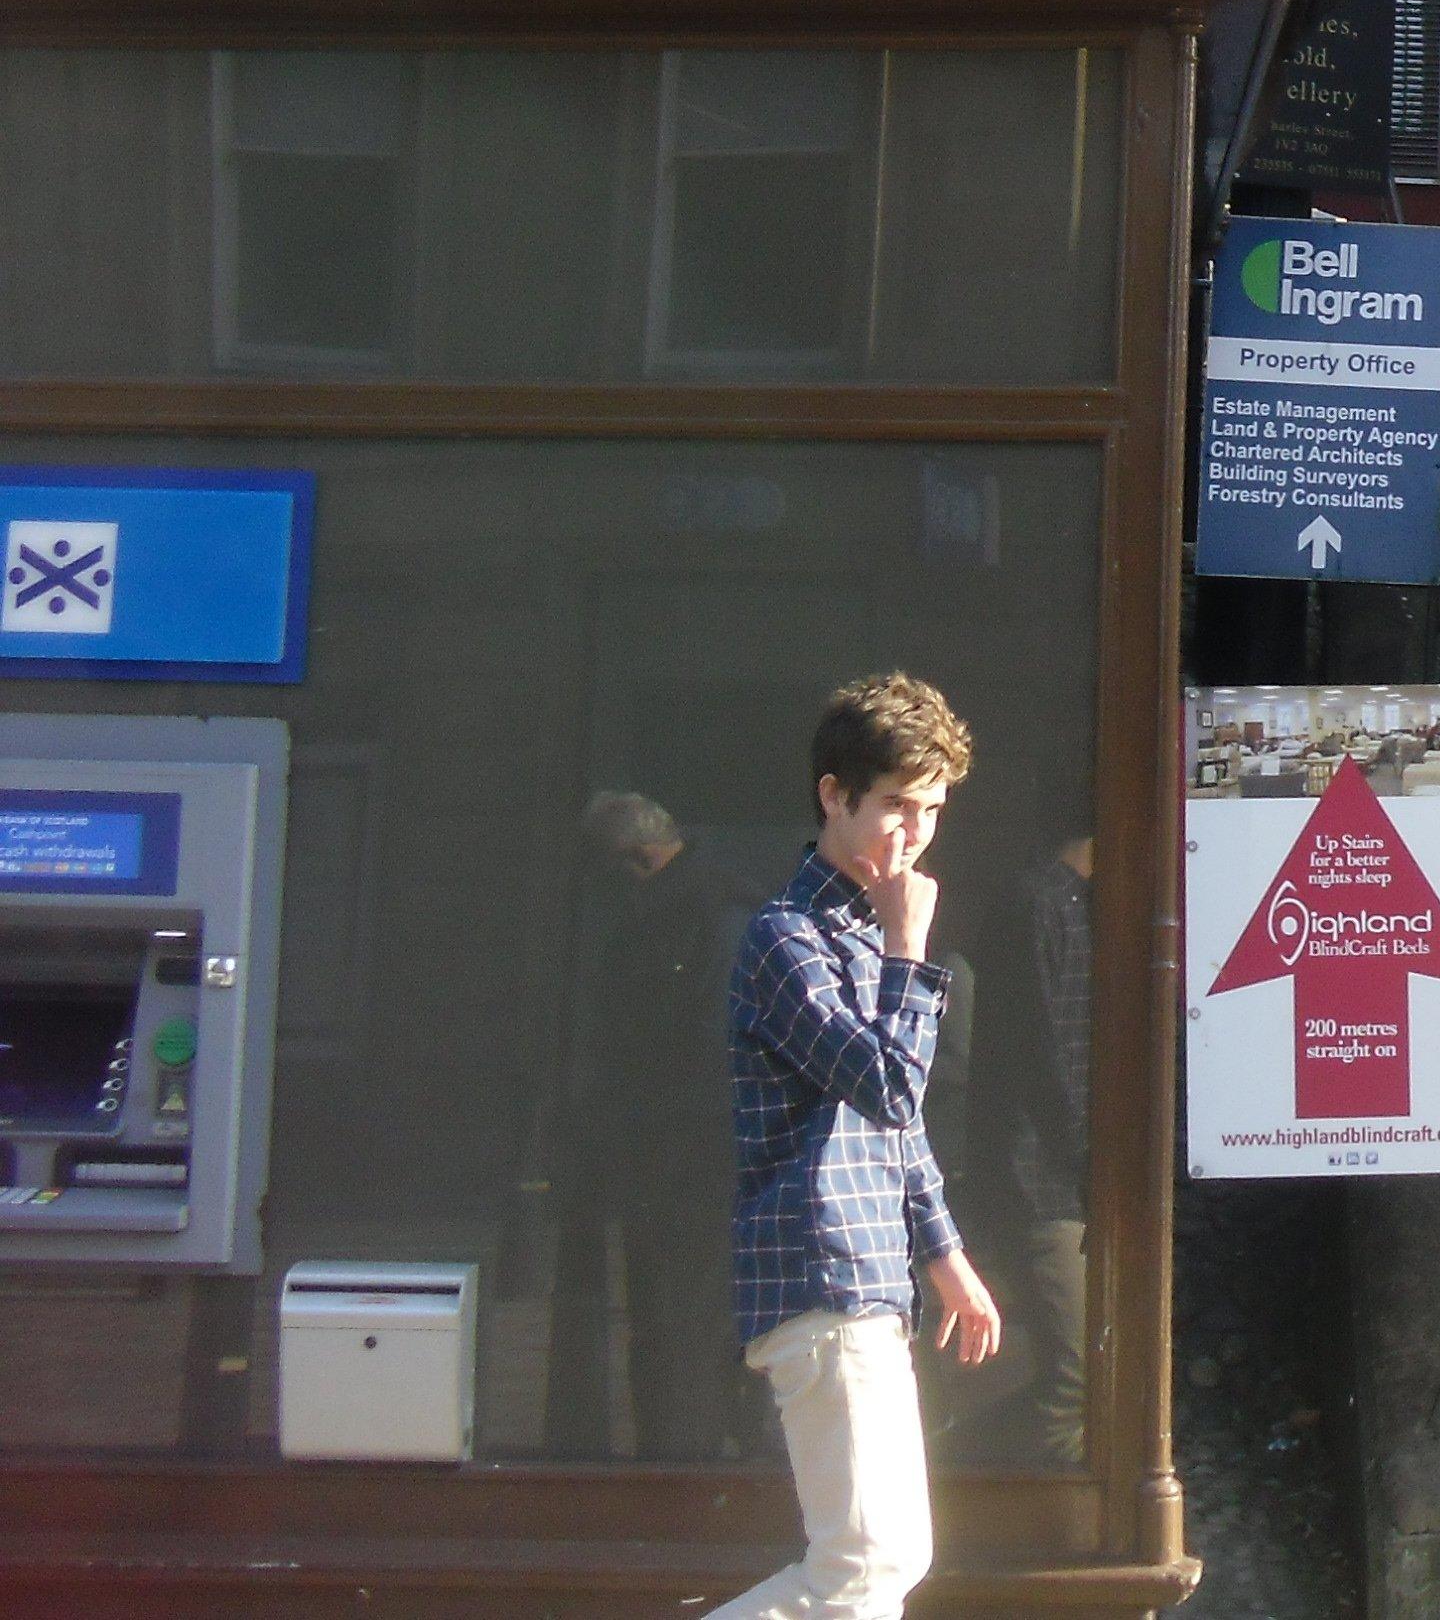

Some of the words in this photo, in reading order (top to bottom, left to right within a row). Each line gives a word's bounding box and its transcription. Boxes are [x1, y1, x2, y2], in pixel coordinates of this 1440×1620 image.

[1283, 239, 1359, 279] Bell
[1281, 278, 1423, 326] Ingram
[1239, 347, 1340, 376] Property
[1347, 353, 1417, 376] Office
[1212, 397, 1271, 417] Estate
[1276, 401, 1397, 423] Management
[1211, 419, 1258, 439] Land
[1263, 422, 1278, 440] &
[1282, 423, 1362, 446] Property
[1367, 428, 1439, 451] Agency
[1210, 441, 1303, 462] Chartered
[1307, 445, 1403, 467] Architects
[1209, 462, 1288, 486] Building
[1292, 466, 1389, 490] Surveyors
[1208, 484, 1287, 508] Forestry
[1291, 487, 1405, 511] Consultants
[1315, 835, 1340, 853] Up
[1342, 834, 1385, 852] Stairs
[1310, 851, 1332, 867] for
[1334, 855, 1344, 867] a
[1347, 852, 1390, 867] better
[1308, 869, 1353, 888] nights
[1355, 869, 1392, 888] sleep
[1308, 938, 1389, 957] BlindCraft
[1392, 937, 1431, 956] Beds
[1305, 1018, 1337, 1038] 200
[1340, 1020, 1399, 1038] metres
[1306, 1040, 1372, 1063] straight
[1374, 1044, 1397, 1059] on
